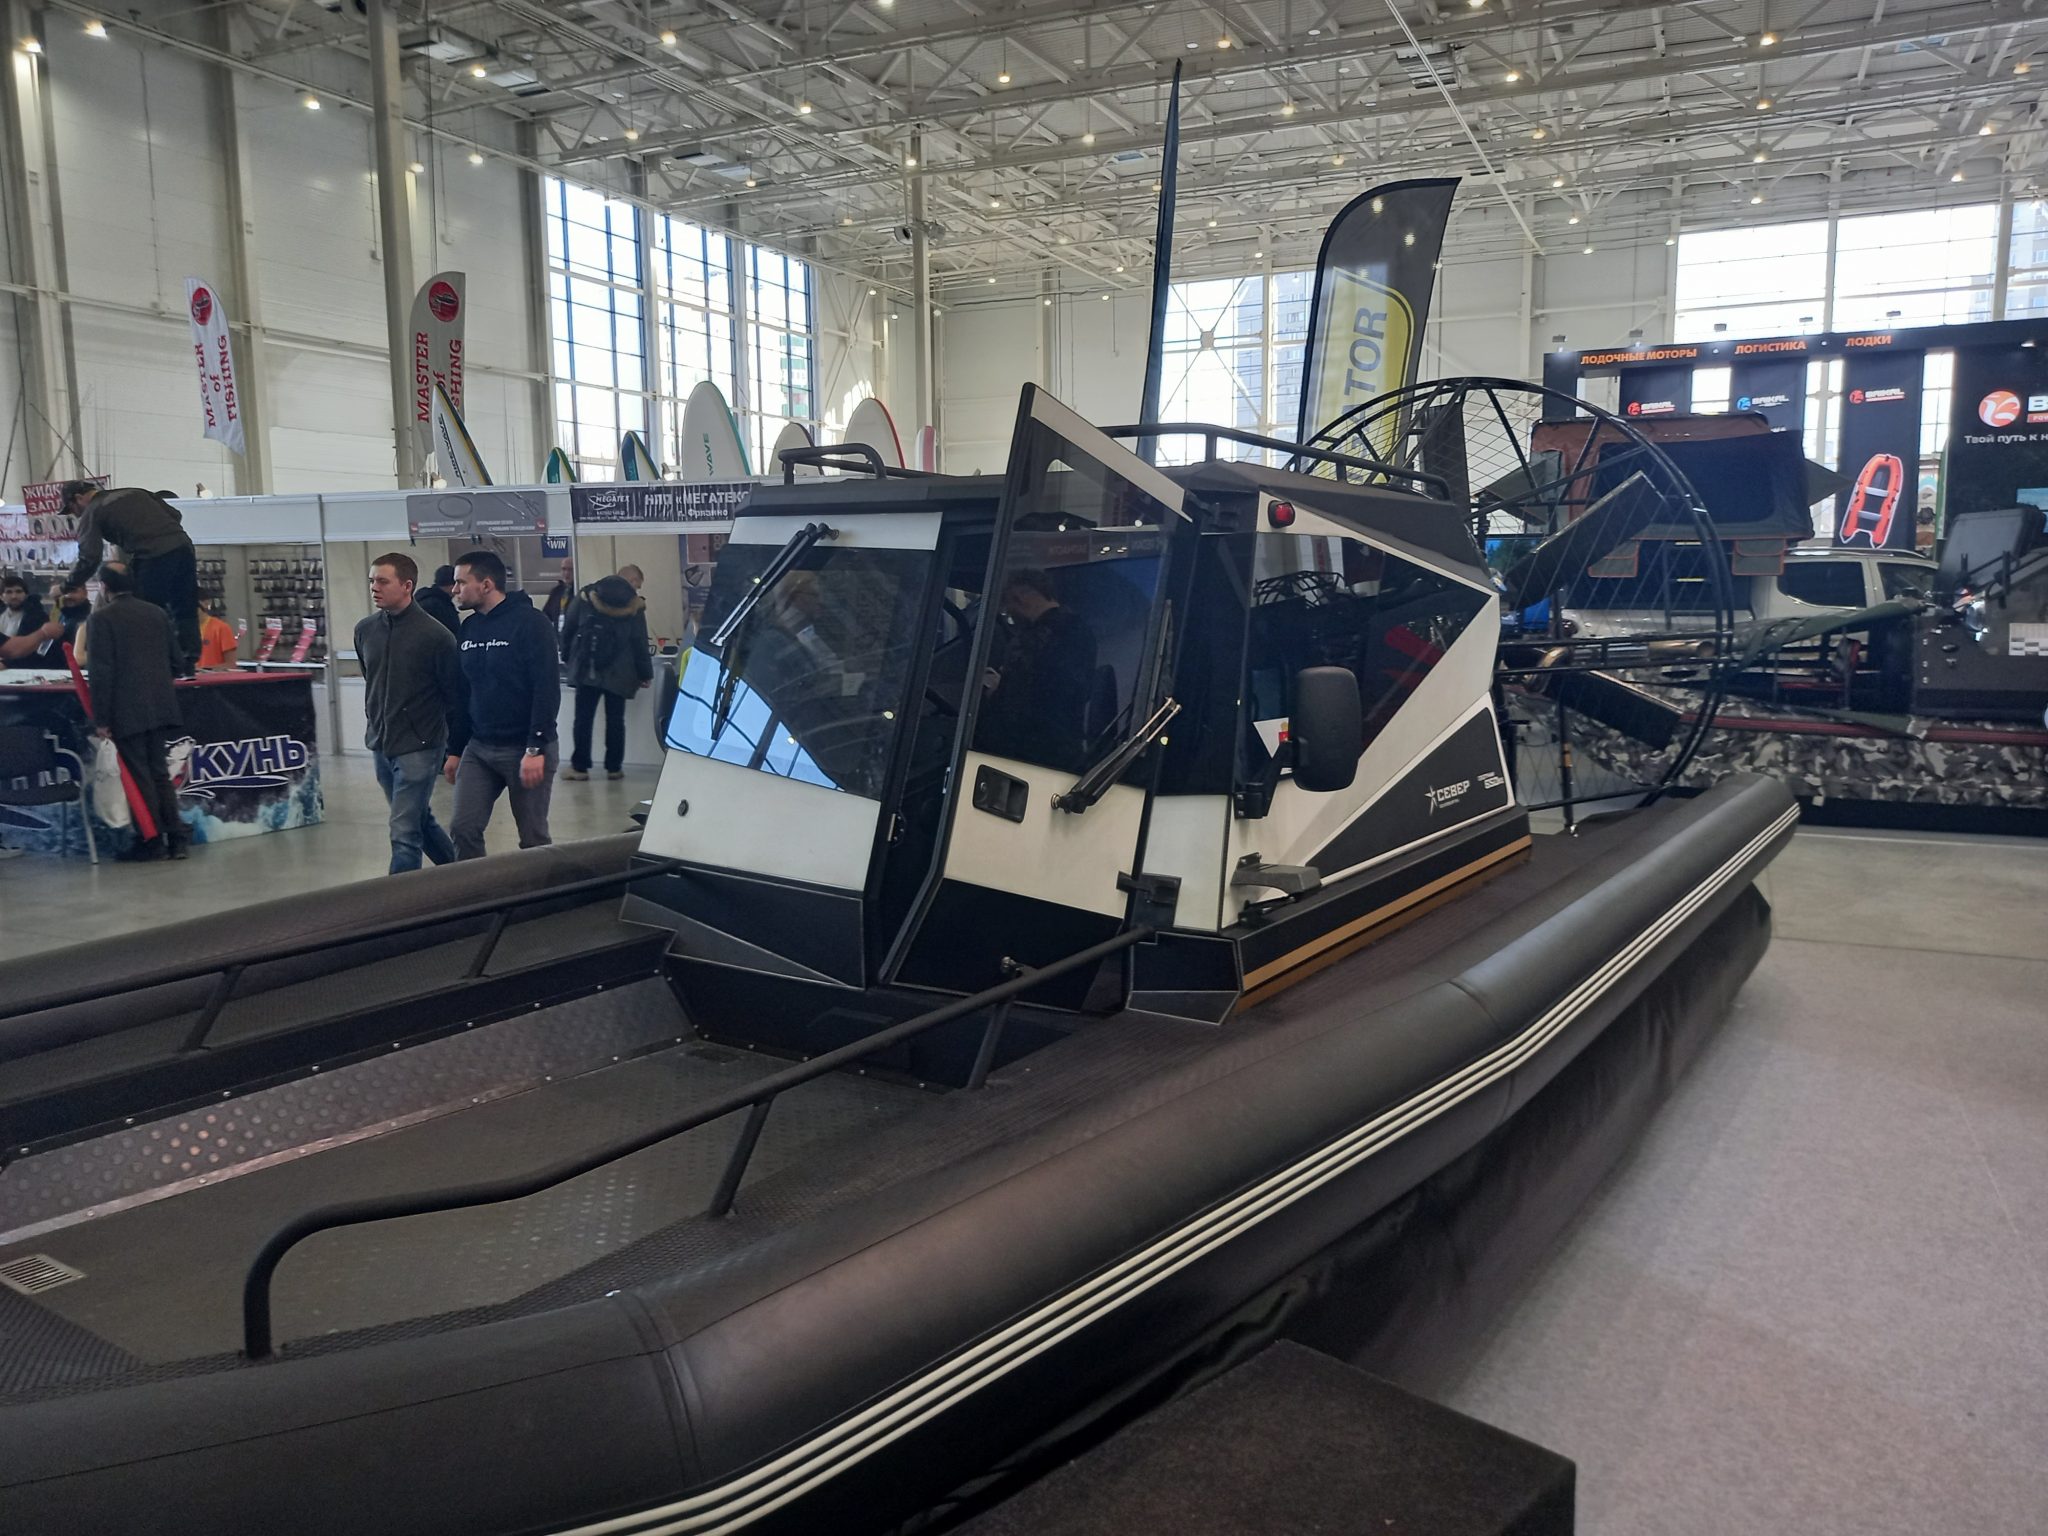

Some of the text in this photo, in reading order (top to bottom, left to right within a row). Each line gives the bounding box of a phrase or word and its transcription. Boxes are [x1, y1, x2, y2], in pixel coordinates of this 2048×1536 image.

[1734, 341, 1806, 355] ЛОГИСТИКА
[1845, 335, 1891, 347] ЛОДКИ
[1580, 348, 1697, 365] ЛОДОЧНЫЕ МОТОРЫ
[218, 335, 238, 422] FISHING
[416, 332, 430, 423] MASTER
[449, 339, 462, 407] SHING
[209, 373, 221, 393] of
[1964, 434, 1995, 444] Твой
[1997, 434, 2027, 444] путь
[23, 483, 64, 499] ЖИДК
[1436, 780, 1470, 802] СЕВЕР
